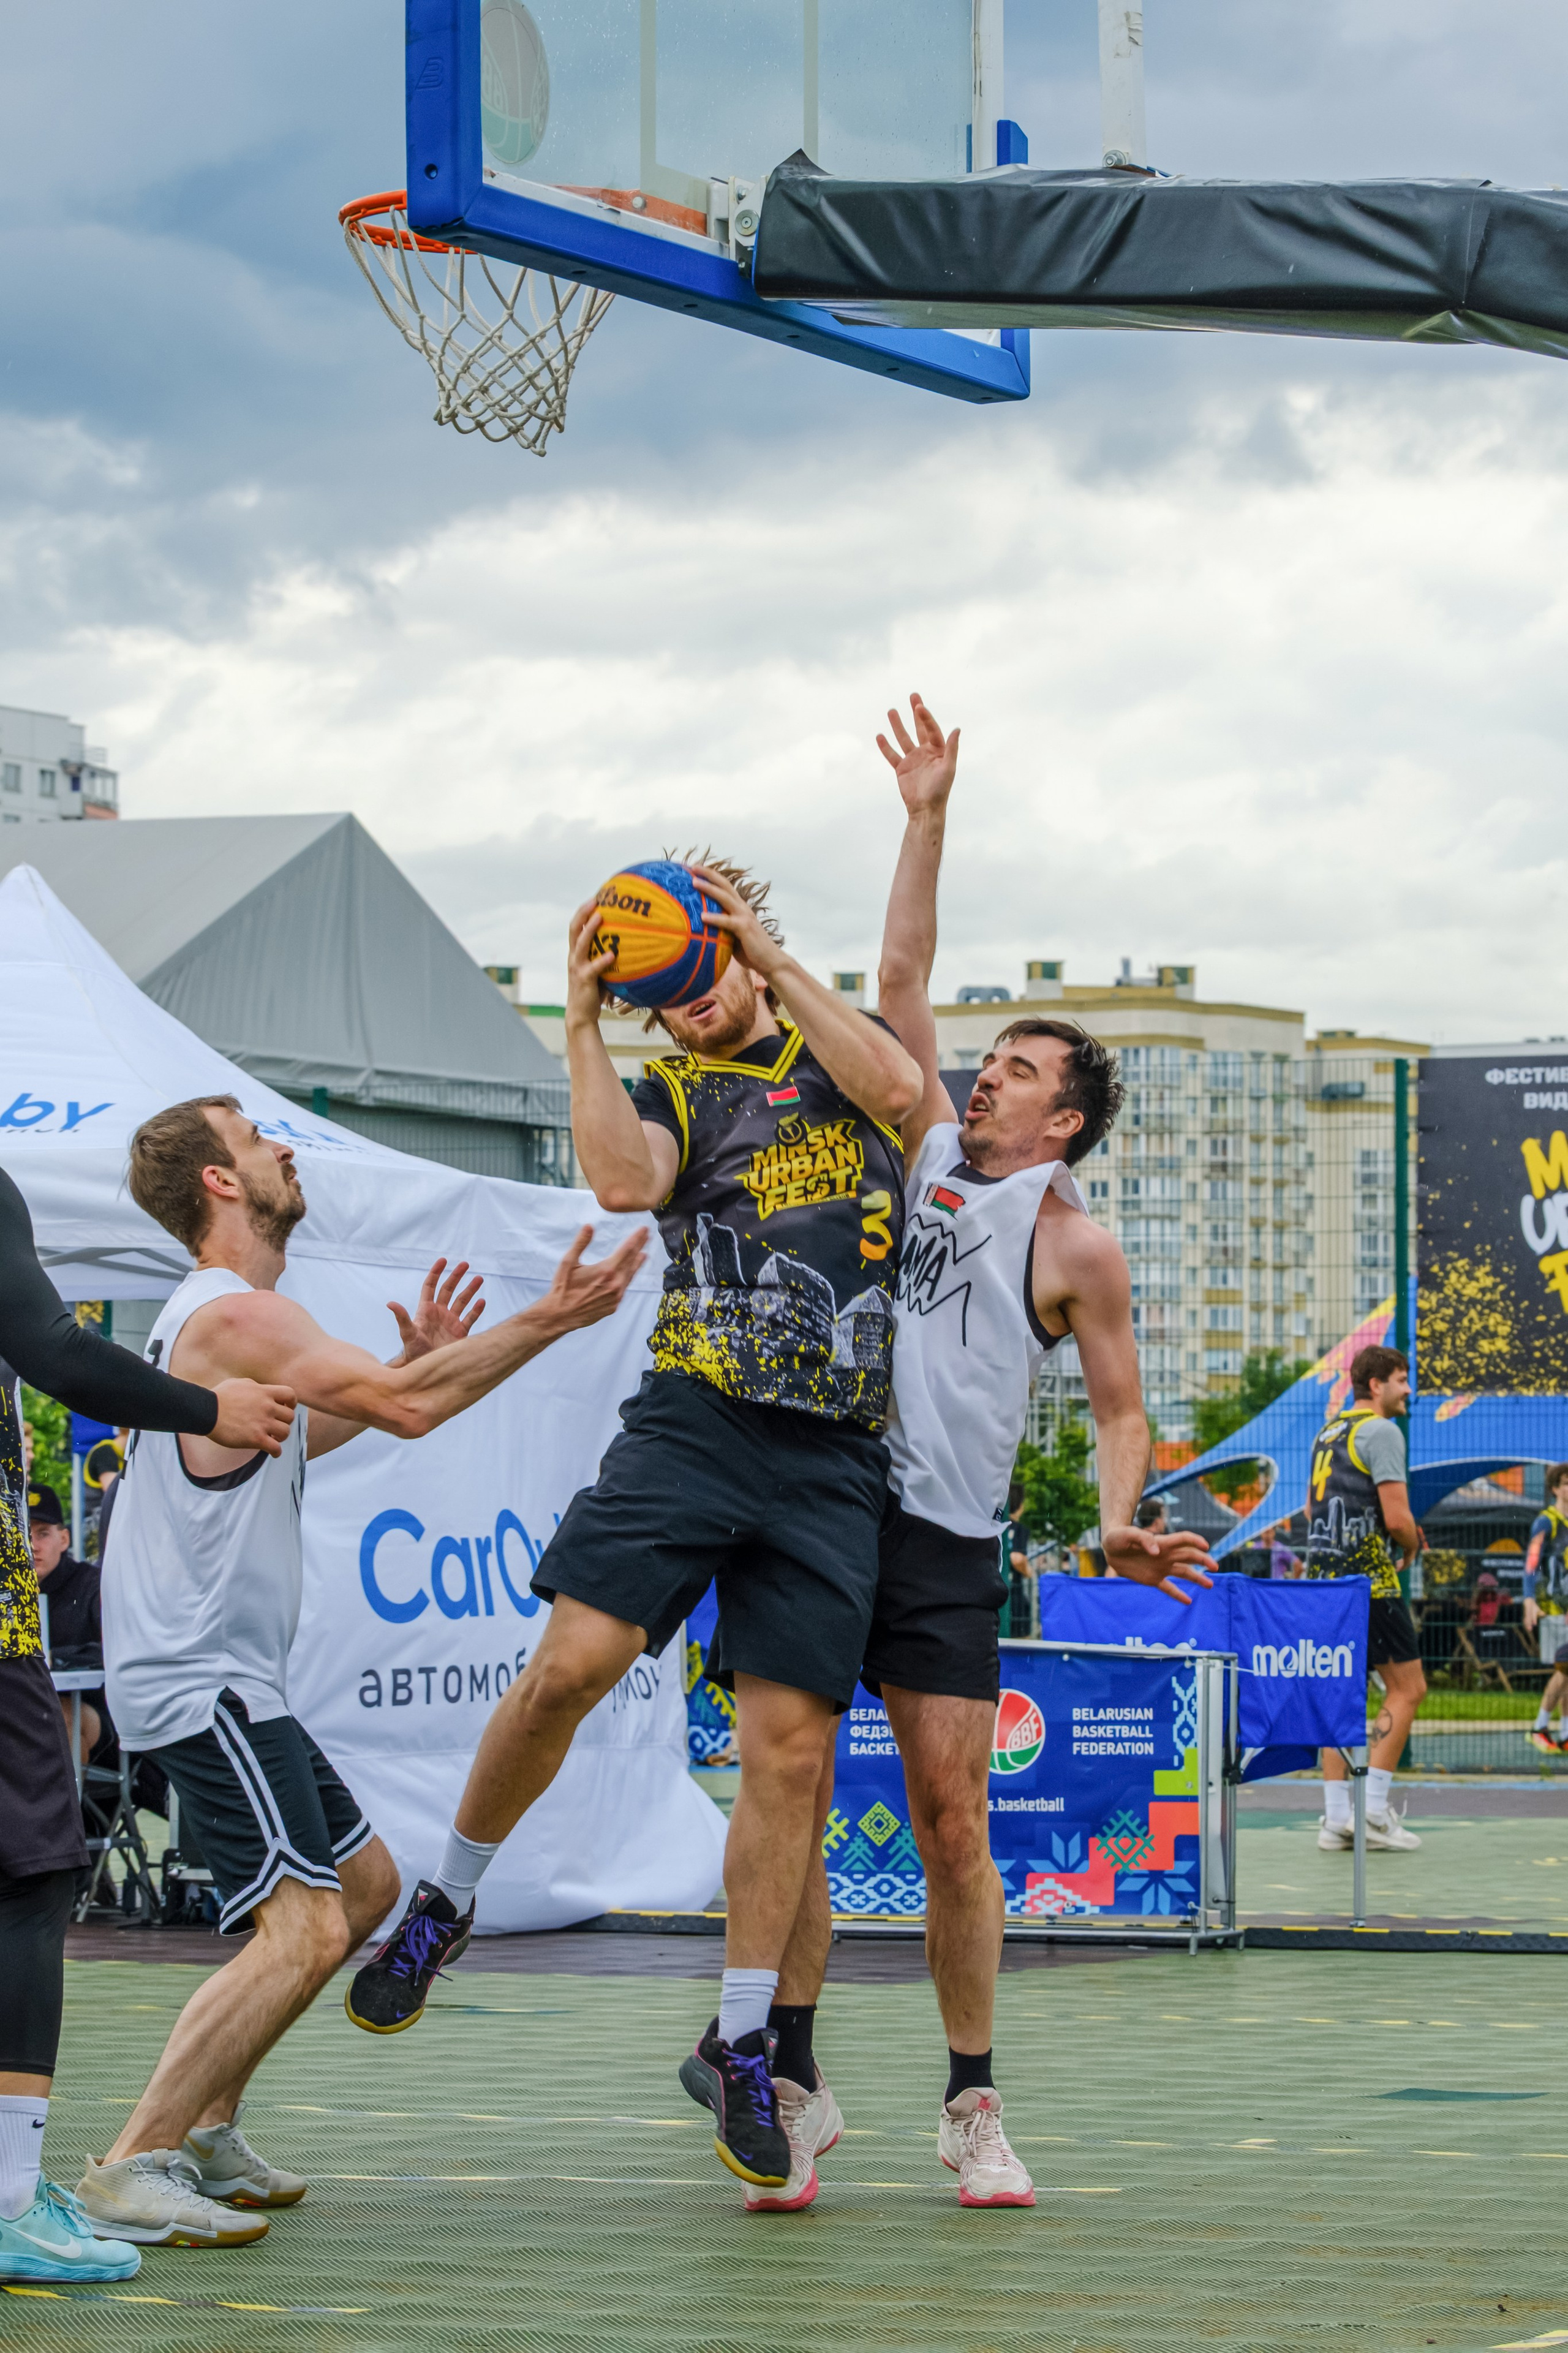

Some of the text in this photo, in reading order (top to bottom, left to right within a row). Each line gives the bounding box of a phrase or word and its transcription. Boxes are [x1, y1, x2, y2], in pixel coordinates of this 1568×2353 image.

[748, 1141, 858, 1192] URBAN
[753, 1122, 848, 1171] MINSK
[860, 1190, 893, 1261] 3
[1312, 1449, 1333, 1501] 4
[1253, 1639, 1352, 1679] molten
[1011, 1712, 1039, 1748] BBF
[1072, 1708, 1153, 1720] BELARUSIAN
[1072, 1726, 1153, 1737] BASKETBALL
[1072, 1742, 1154, 1755] FEDERATION
